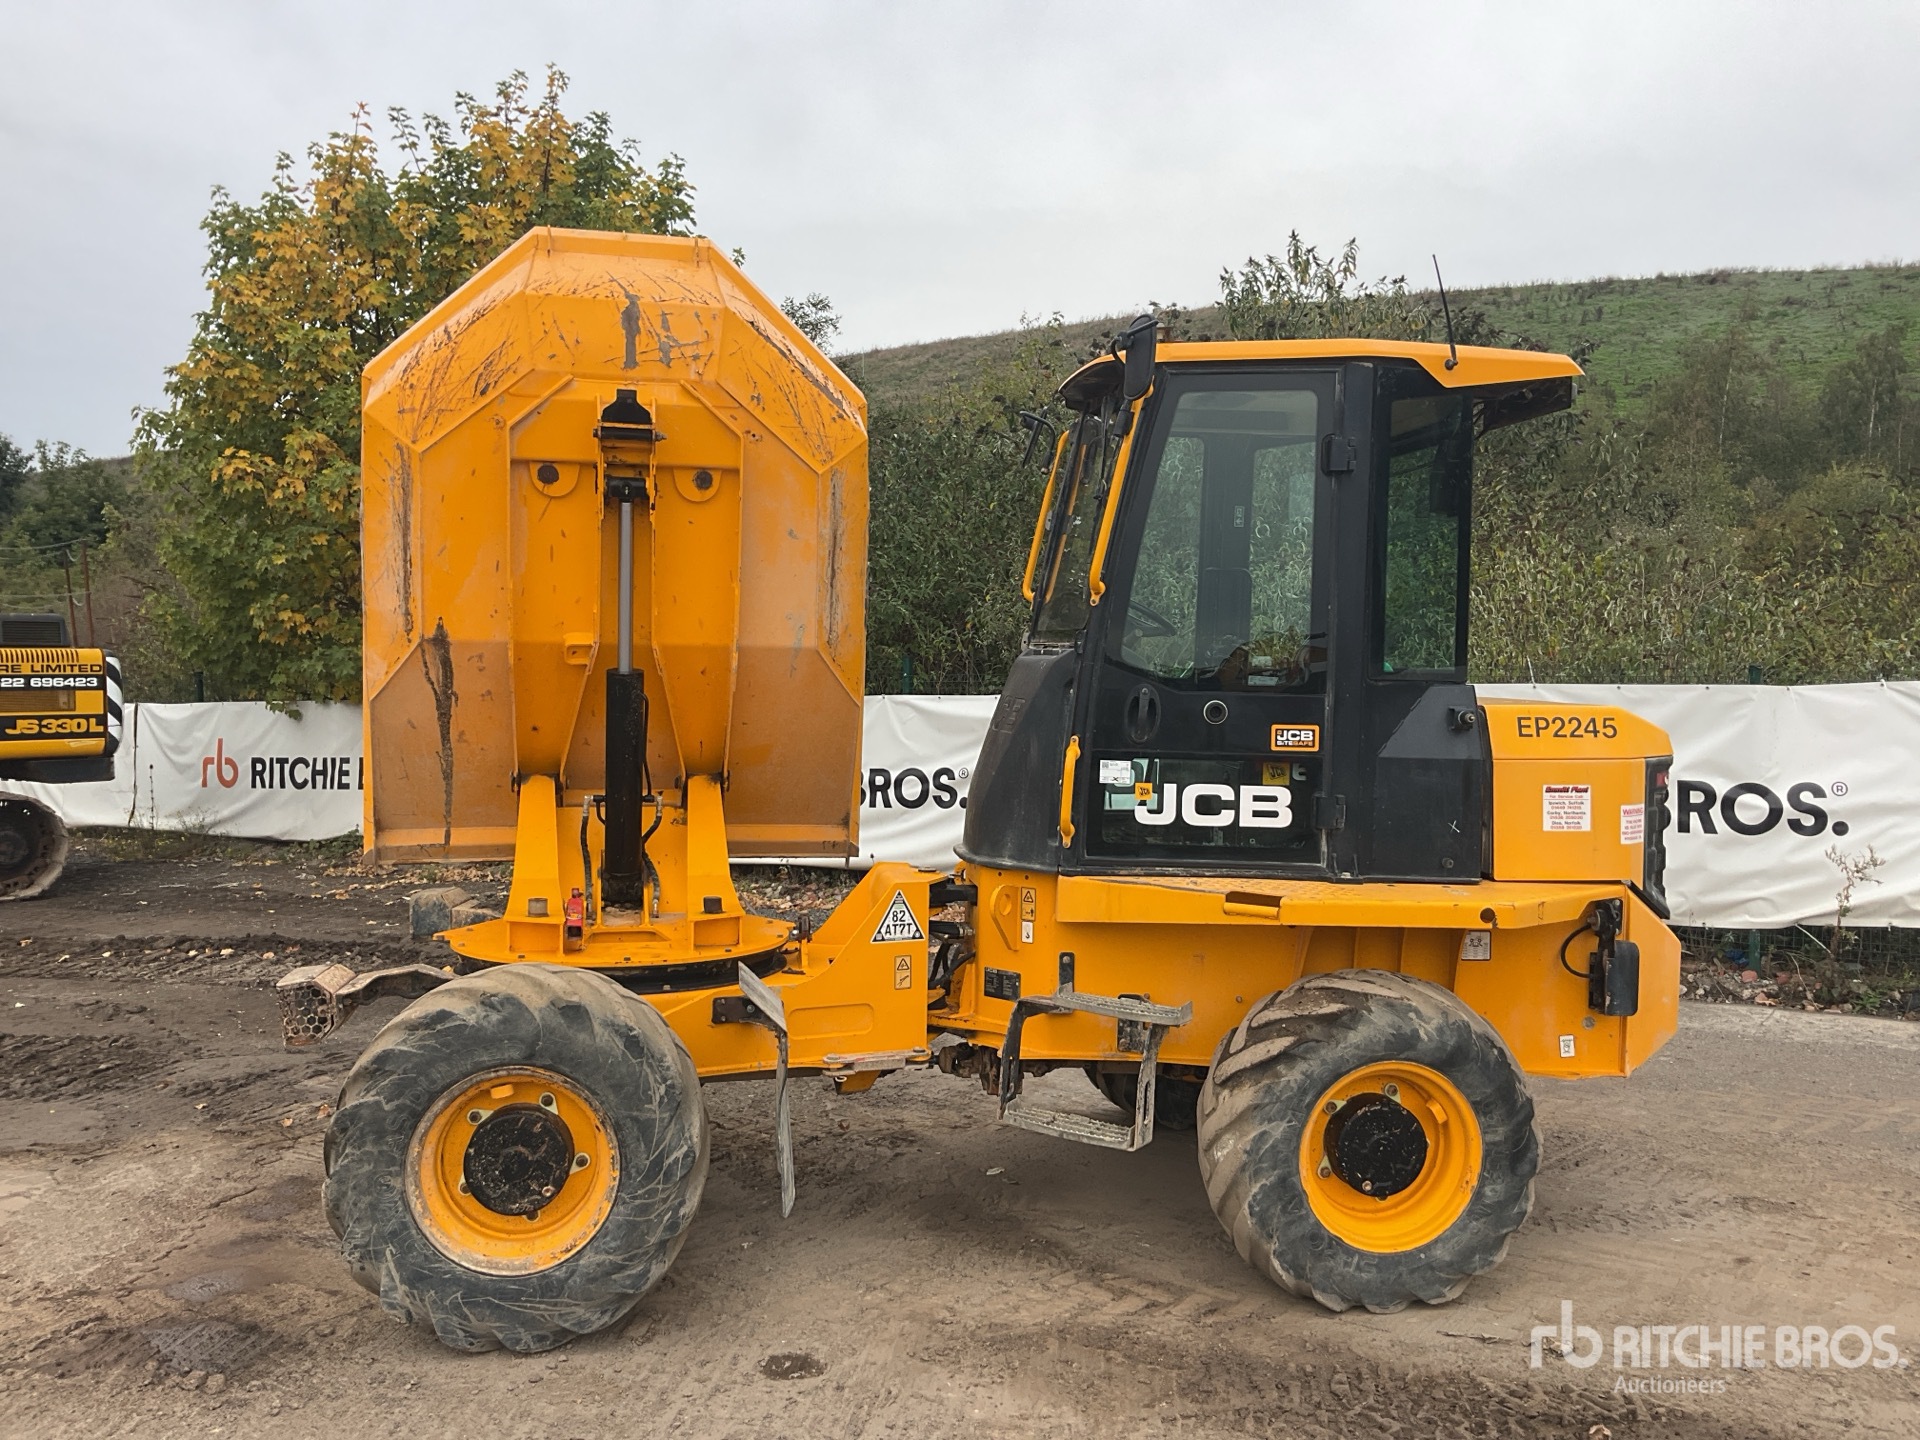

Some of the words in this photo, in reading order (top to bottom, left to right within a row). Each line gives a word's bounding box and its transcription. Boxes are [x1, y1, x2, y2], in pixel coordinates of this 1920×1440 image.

[30, 664, 103, 674] LIMITED
[0, 677, 25, 687] 22
[30, 677, 98, 688] 696423
[1276, 730, 1314, 741] JCB
[1517, 716, 1618, 739] EP2245
[201, 738, 239, 789] rb
[251, 756, 351, 790] RITCHIE
[860, 767, 968, 809] ROS.
[1134, 783, 1293, 828] JCB
[1665, 779, 1850, 837] ROS.
[892, 910, 906, 922] 82
